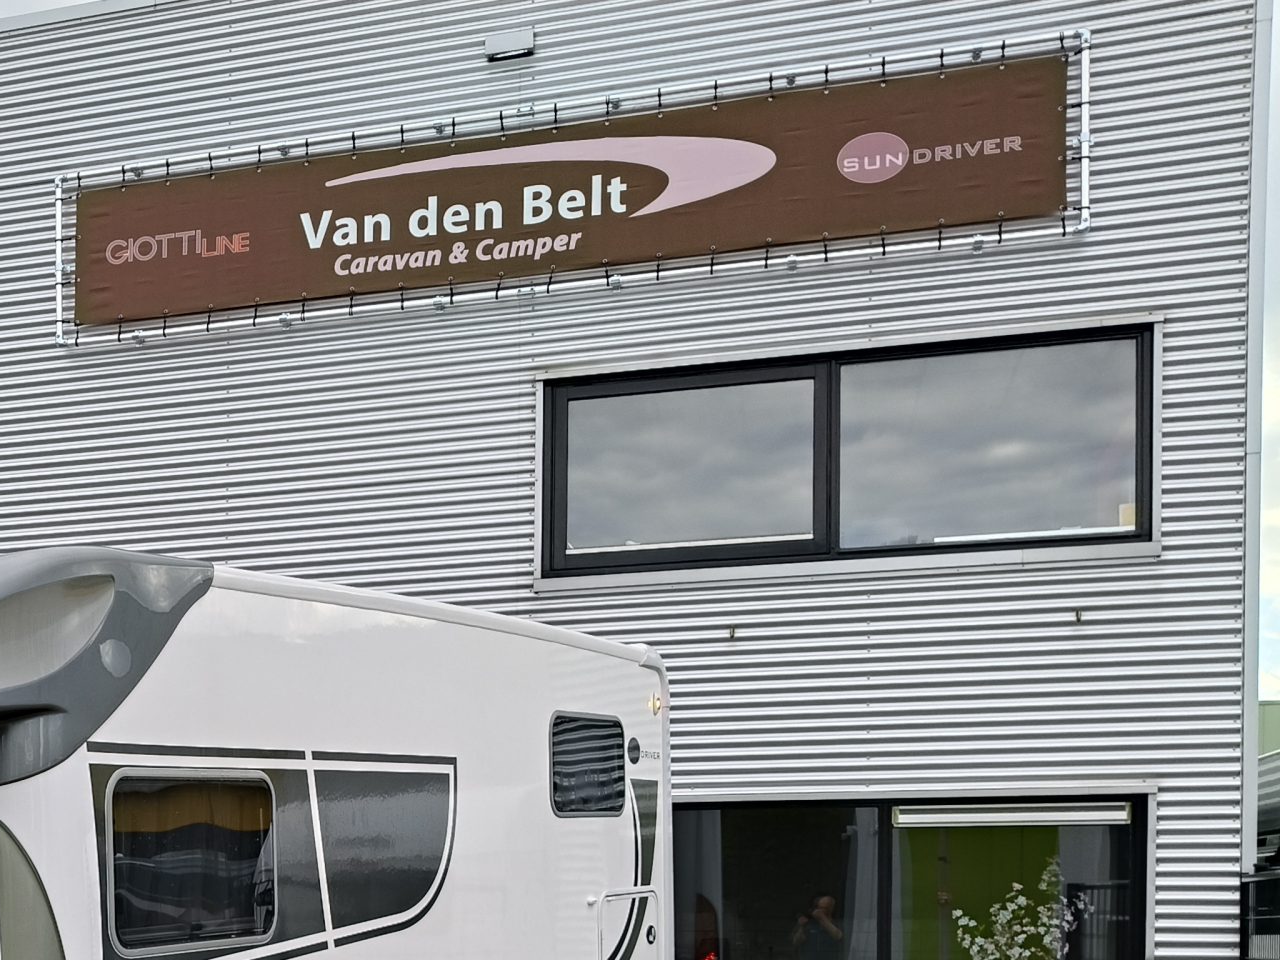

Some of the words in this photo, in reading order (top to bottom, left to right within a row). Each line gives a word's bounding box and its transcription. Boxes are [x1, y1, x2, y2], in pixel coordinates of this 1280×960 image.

[842, 152, 903, 172] SUN
[912, 135, 1023, 165] DRIVER
[299, 209, 392, 250] Van
[408, 195, 503, 238] den
[522, 174, 628, 226] Belt
[334, 245, 442, 276] Caravan
[448, 242, 470, 265] &
[475, 231, 583, 261] Camper
